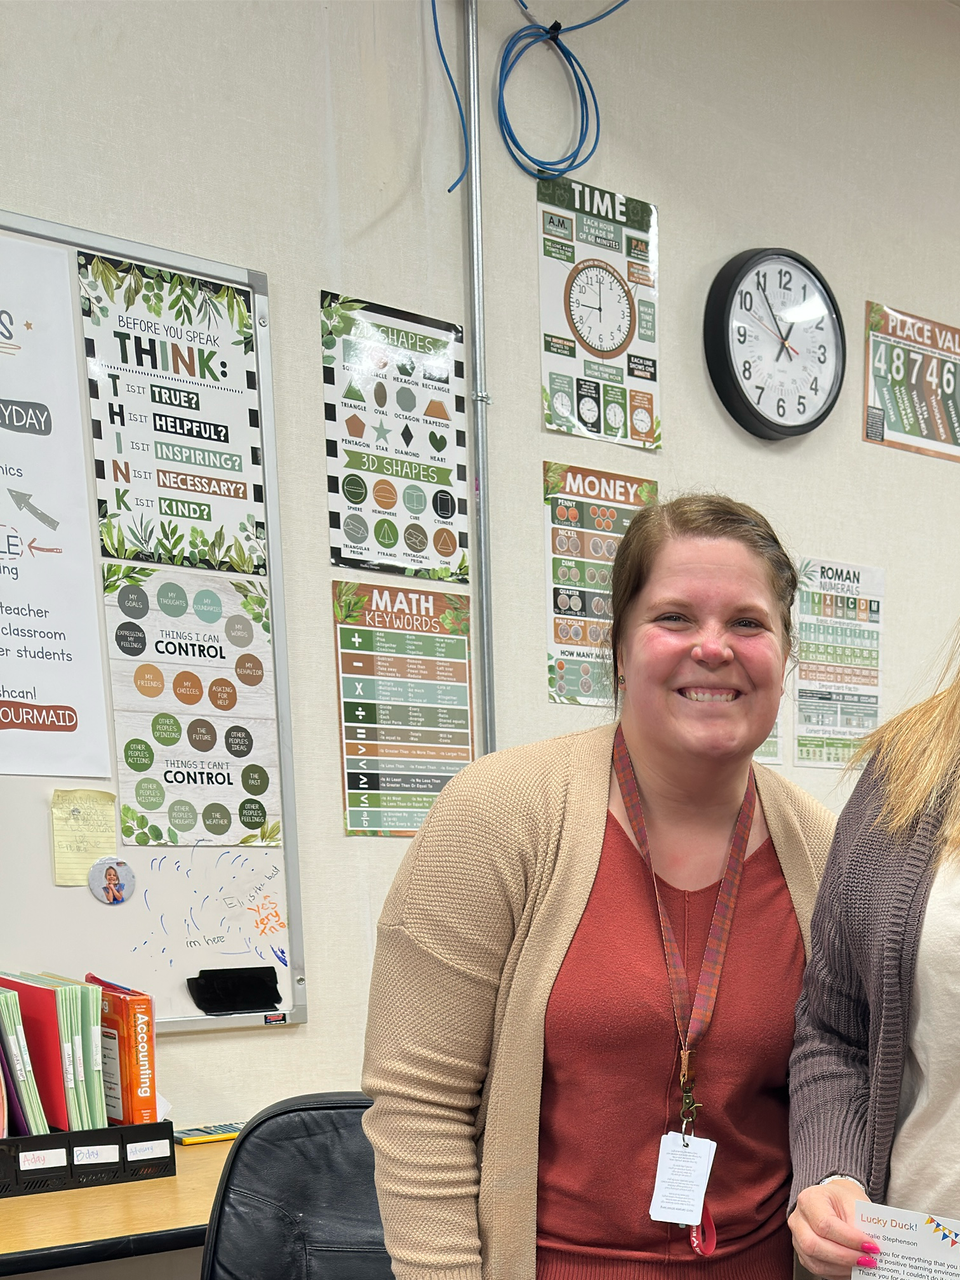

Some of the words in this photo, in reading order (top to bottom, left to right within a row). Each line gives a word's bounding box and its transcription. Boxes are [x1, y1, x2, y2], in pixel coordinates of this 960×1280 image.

[571, 182, 627, 222] TIME
[548, 216, 568, 230] A.M.
[583, 217, 599, 228] EACH
[599, 222, 614, 232] HOUR
[589, 227, 606, 237] MADE
[596, 237, 620, 249] MINUTES
[755, 270, 767, 293] 11
[778, 268, 792, 292] 12
[738, 289, 753, 312] 10
[118, 315, 161, 335] BEFORE
[163, 325, 183, 340] YOU
[186, 330, 220, 348] SPEAK
[737, 325, 747, 345] 9
[888, 315, 932, 345] PLACE
[379, 327, 434, 354] SHAPES
[113, 330, 228, 382] THINK:
[817, 345, 827, 365] 3
[742, 360, 752, 381] 8
[107, 373, 121, 397] T
[126, 384, 135, 393] IS
[137, 385, 147, 395] IT
[151, 386, 198, 408] TRUE?
[393, 376, 419, 387] HEXAGON
[809, 376, 819, 396] 4
[755, 385, 765, 406] 7
[341, 401, 367, 412] TRIANGLE
[776, 398, 786, 418] 6
[797, 395, 806, 415] 5
[881, 387, 896, 423] MILLIONS
[0, 405, 48, 431] YDAY
[108, 402, 126, 427] H
[128, 413, 138, 422] IS
[140, 414, 148, 423] IT
[155, 415, 227, 441] HELPFUL?
[394, 412, 420, 423] OCTAGON
[422, 418, 450, 429] TRAPEZOID
[115, 432, 123, 454] I
[130, 441, 140, 450] IS
[141, 442, 150, 452] IT
[156, 443, 240, 470] INSPIRING?
[341, 438, 371, 449] PENTAGON
[394, 448, 420, 458] DIAMOND
[430, 455, 446, 463] HEART
[361, 453, 378, 471] 3D
[383, 458, 438, 483] SHAPES
[112, 459, 131, 484] N
[132, 470, 142, 479] IS
[143, 471, 152, 480] IT
[158, 471, 245, 498] NECESSARY?
[565, 472, 638, 503] MONEY
[115, 487, 132, 512] K
[135, 498, 144, 507] IS
[145, 499, 154, 508] IT
[160, 500, 209, 519] KIND?
[557, 499, 576, 507] PENNY
[558, 529, 577, 538] NICKEL
[820, 566, 860, 584] ROMAN
[819, 581, 860, 597] NUMERALS
[0, 603, 50, 619] teacher
[125, 600, 143, 608] GOALS
[160, 598, 186, 607] THOUGHTS
[371, 589, 434, 616] MATH
[365, 610, 440, 633] KEYWORDS
[1, 622, 67, 641] classroom
[159, 629, 193, 641] THINGS
[195, 632, 200, 641] I
[202, 633, 220, 643] CAN
[16, 646, 73, 663] students
[154, 640, 226, 660] CONTROL
[575, 651, 594, 659] MANY
[138, 680, 162, 688] FRIENDS
[176, 687, 200, 695] CHOICES
[0, 706, 77, 726] OURMAID
[154, 731, 180, 739] OPINIONS
[164, 759, 198, 770] THINGS
[200, 761, 204, 769] I
[207, 761, 230, 770] CAN'T
[163, 770, 234, 785] CONTROL
[136, 1013, 152, 1098] Accounting
[860, 1213, 887, 1228] Lucky
[890, 1219, 918, 1231] Duck!
[881, 1235, 918, 1247] Stephenson
[884, 1259, 907, 1269] positive
[908, 1263, 933, 1275] learning
[901, 1255, 933, 1266] everything
[933, 1260, 946, 1268] that
[946, 1263, 958, 1271] you
[858, 1269, 877, 1278] Thank
[890, 1273, 899, 1280] for
[906, 1270, 930, 1280] couldn't
